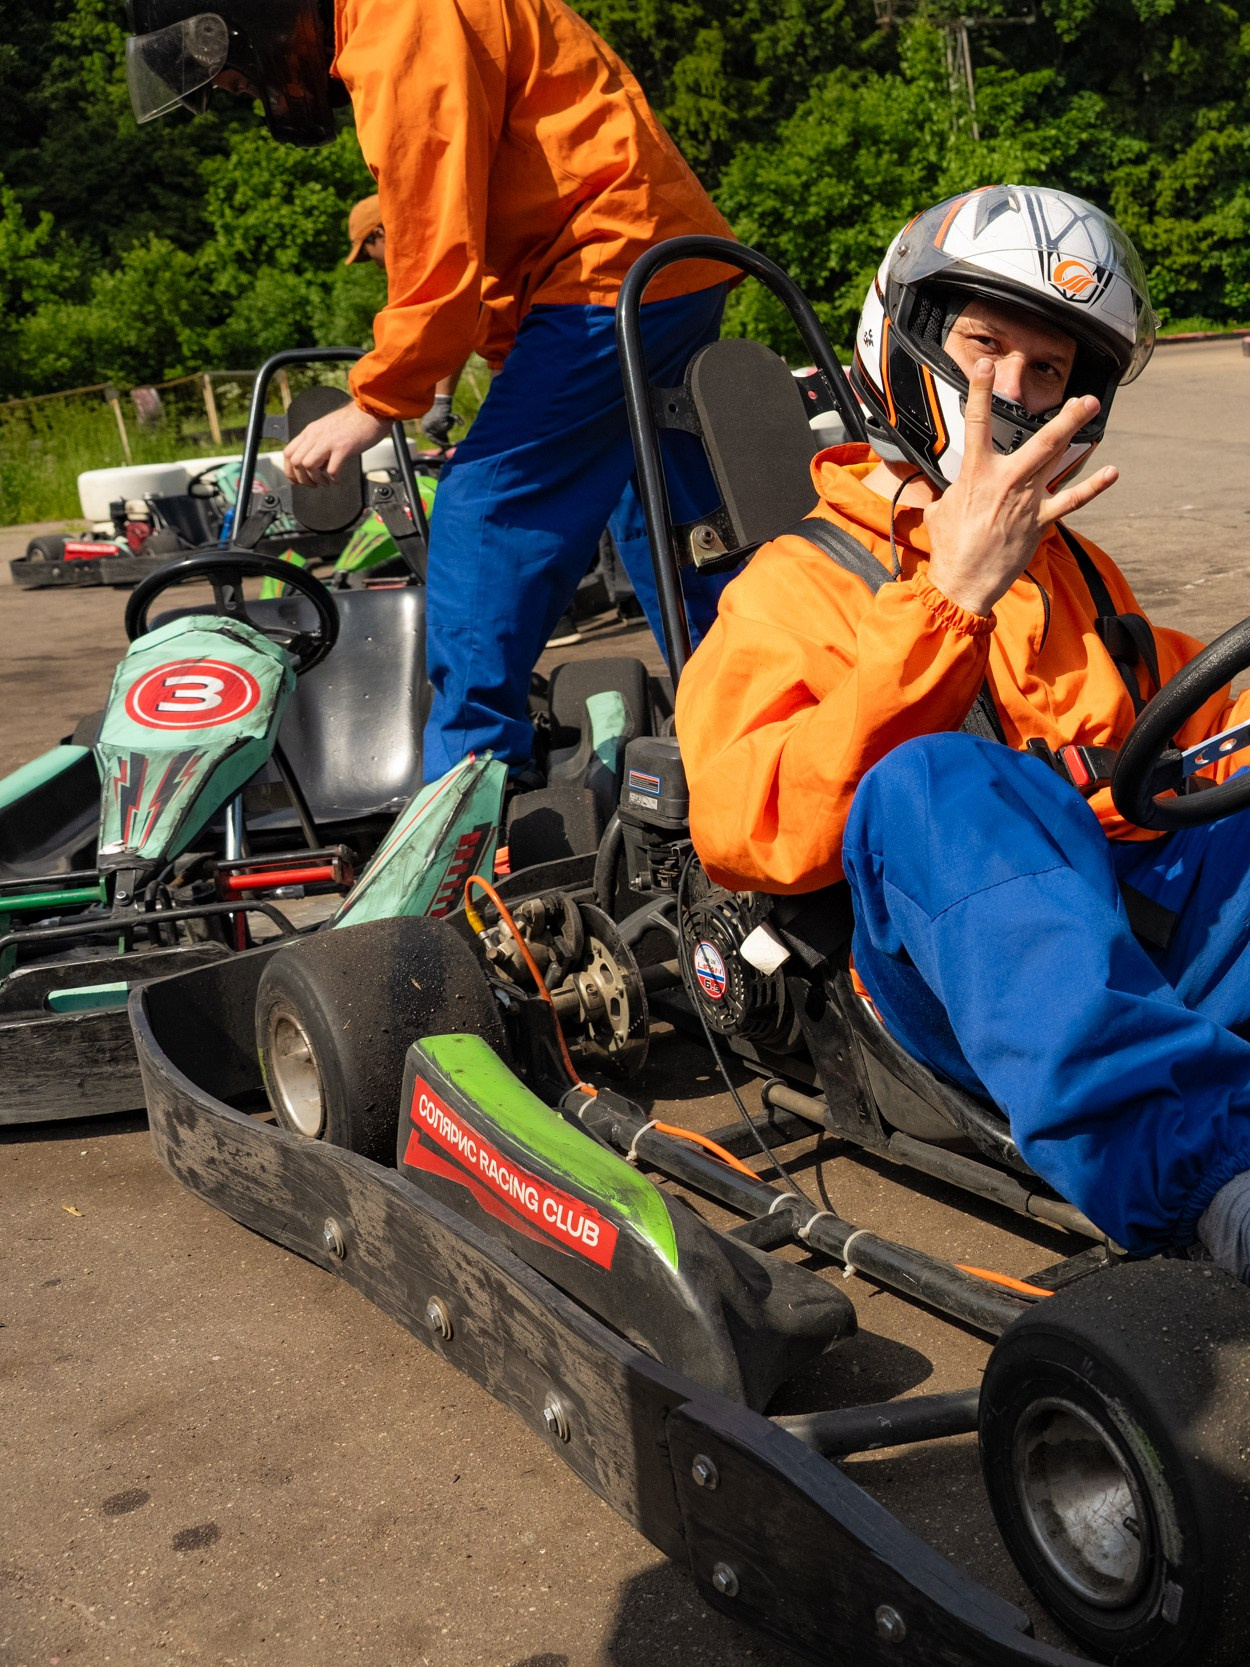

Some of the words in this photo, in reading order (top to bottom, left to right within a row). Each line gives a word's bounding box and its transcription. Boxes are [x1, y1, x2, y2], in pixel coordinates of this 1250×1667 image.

[155, 675, 225, 713] 3
[418, 1094, 477, 1163] СОЛЯРИС
[479, 1149, 539, 1213] RACING
[542, 1198, 600, 1247] CLUB
